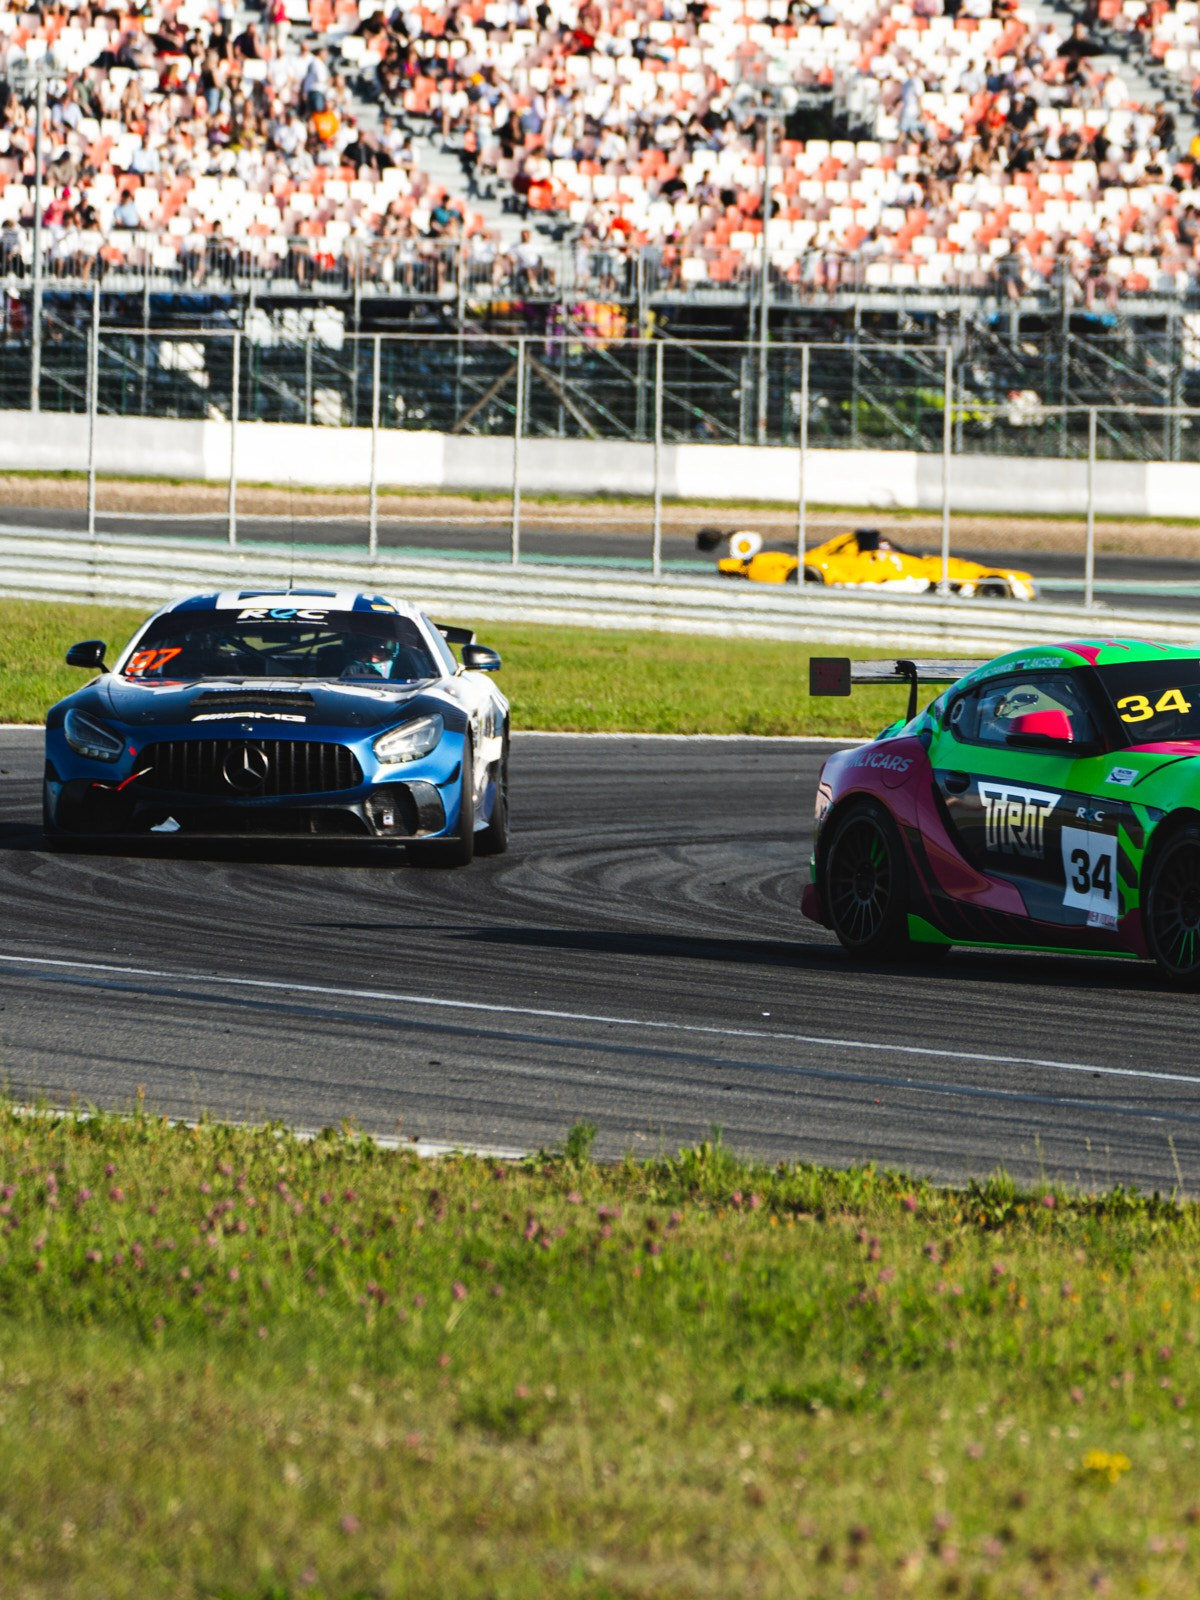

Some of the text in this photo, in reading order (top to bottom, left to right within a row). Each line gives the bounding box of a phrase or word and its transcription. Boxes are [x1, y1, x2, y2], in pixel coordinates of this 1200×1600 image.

[125, 647, 183, 674] 97
[232, 711, 307, 723] AMG
[1116, 688, 1192, 724] 34
[1070, 847, 1113, 901] 34
